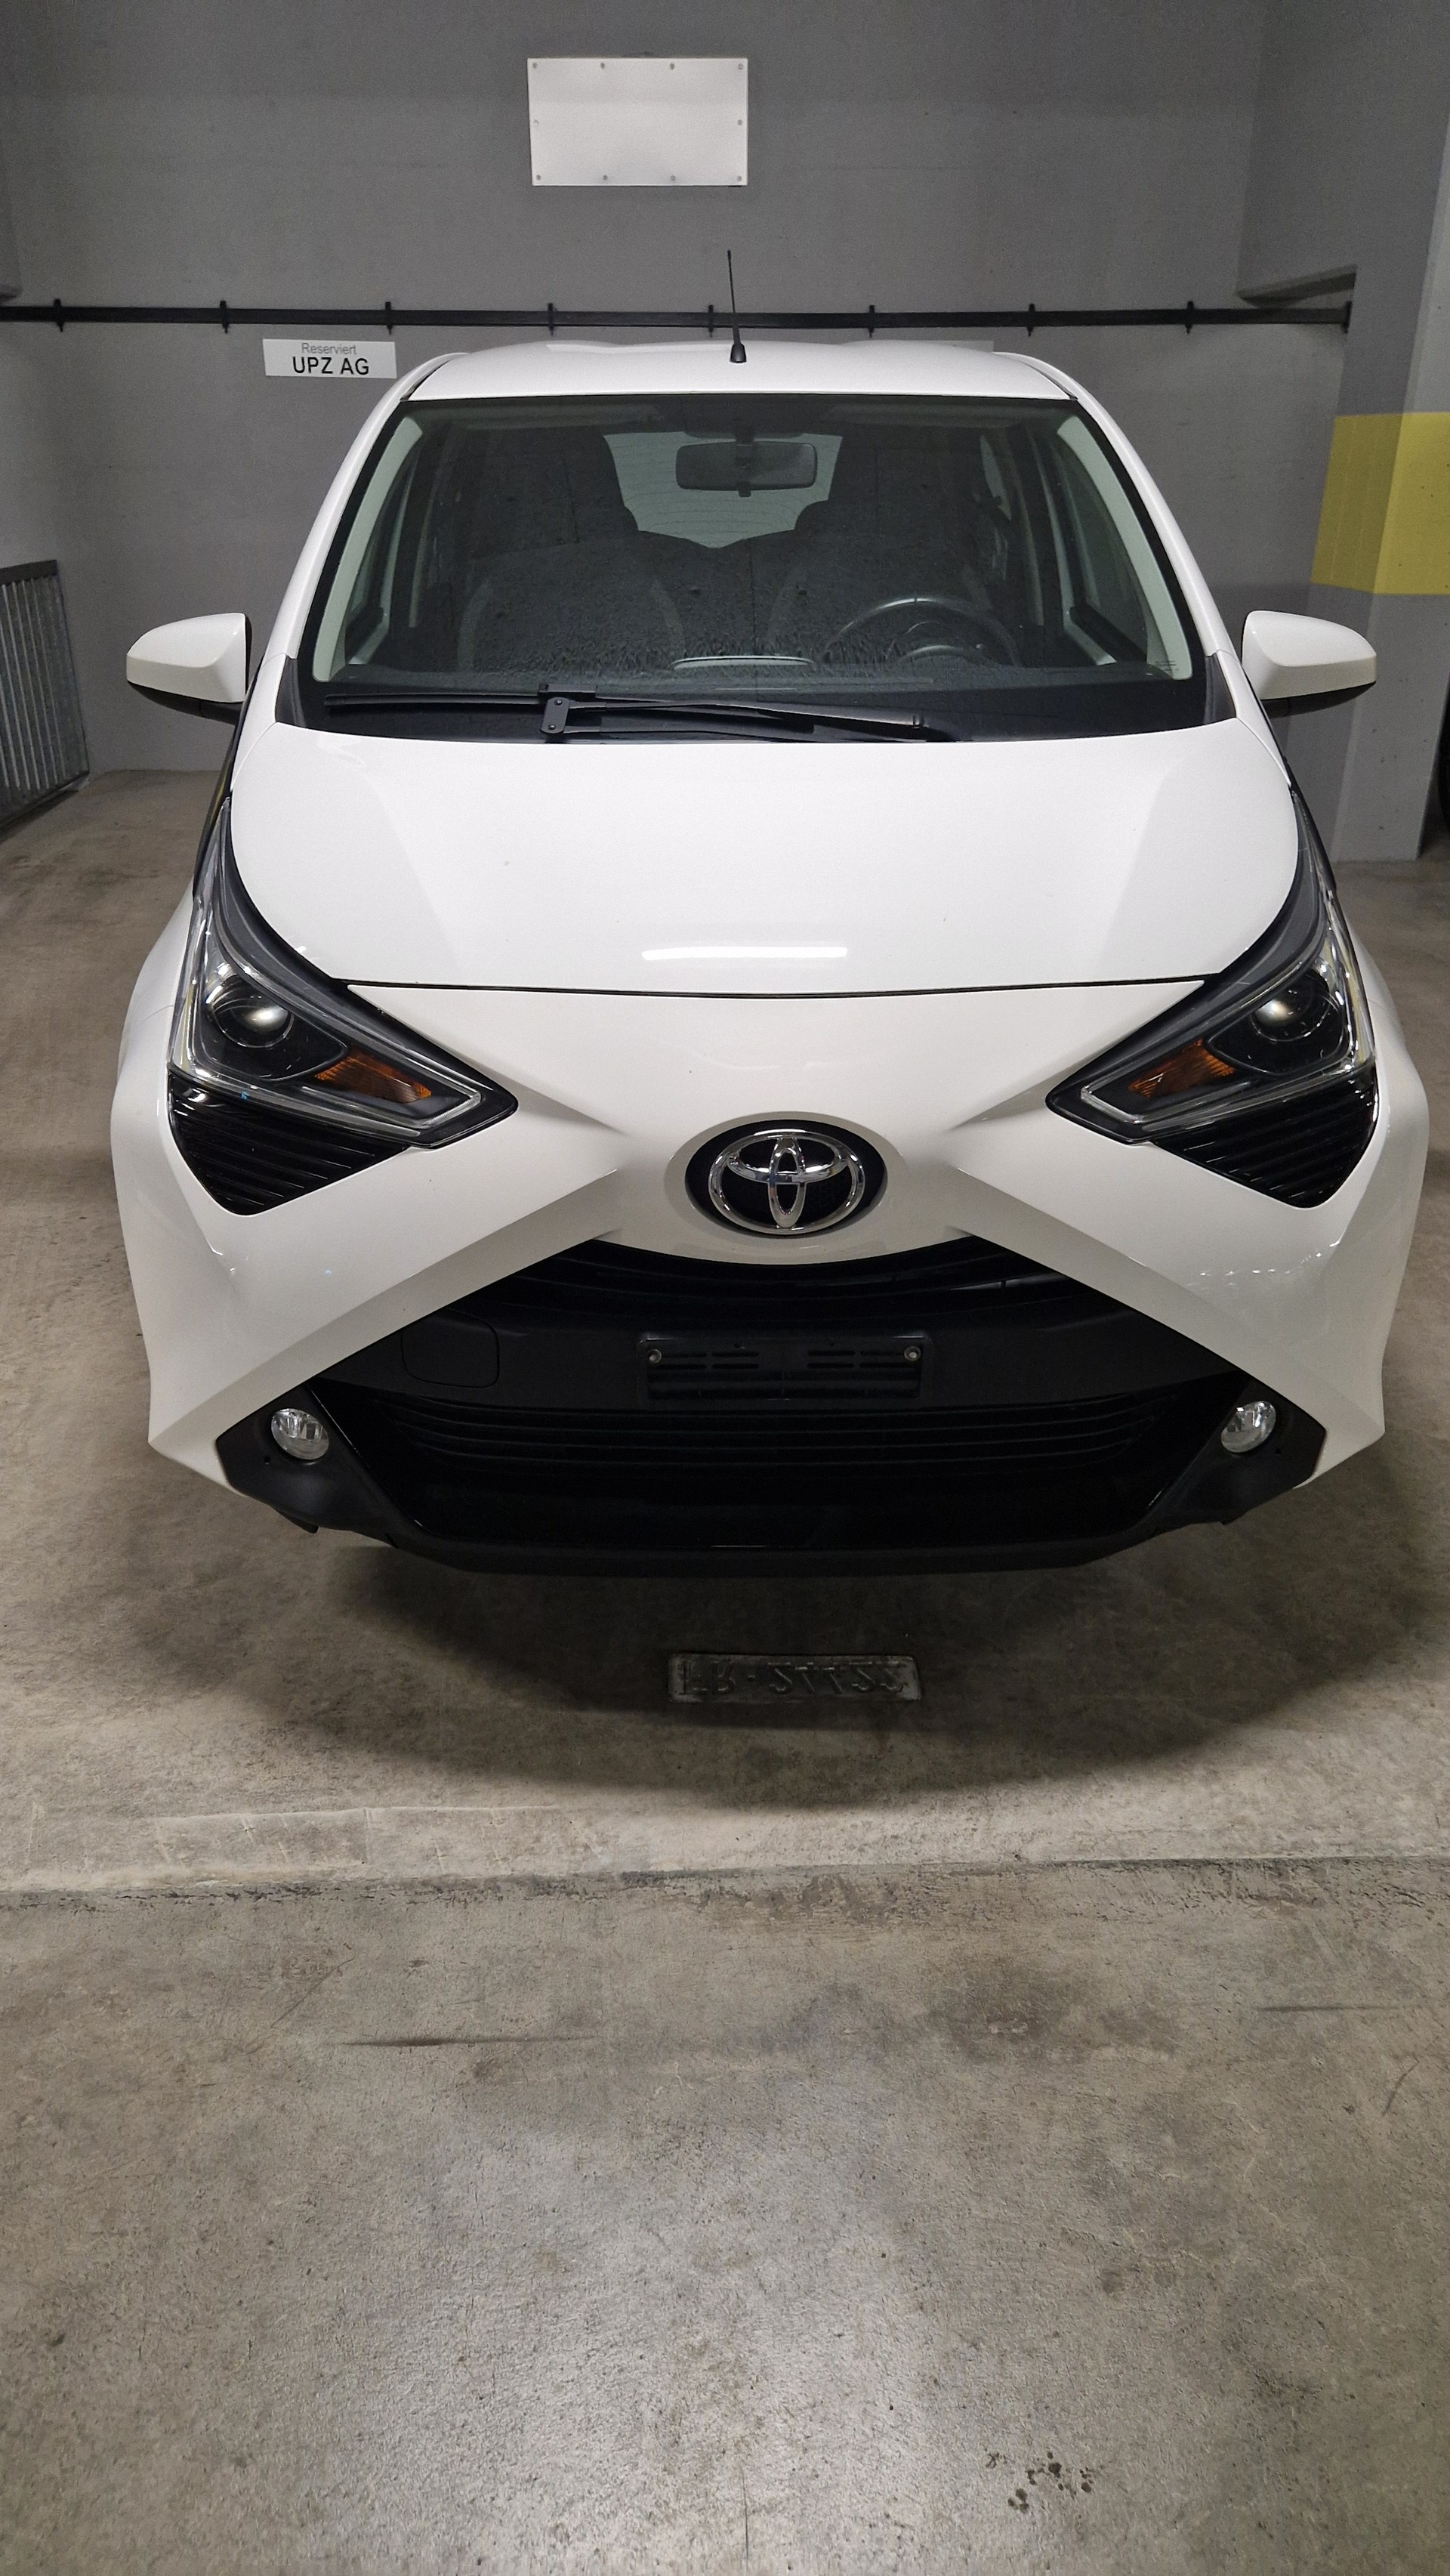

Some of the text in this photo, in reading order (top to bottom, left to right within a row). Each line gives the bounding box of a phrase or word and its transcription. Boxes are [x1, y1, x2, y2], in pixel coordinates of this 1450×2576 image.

[301, 342, 356, 355] Reserviert
[292, 357, 369, 375] UPZ AG
